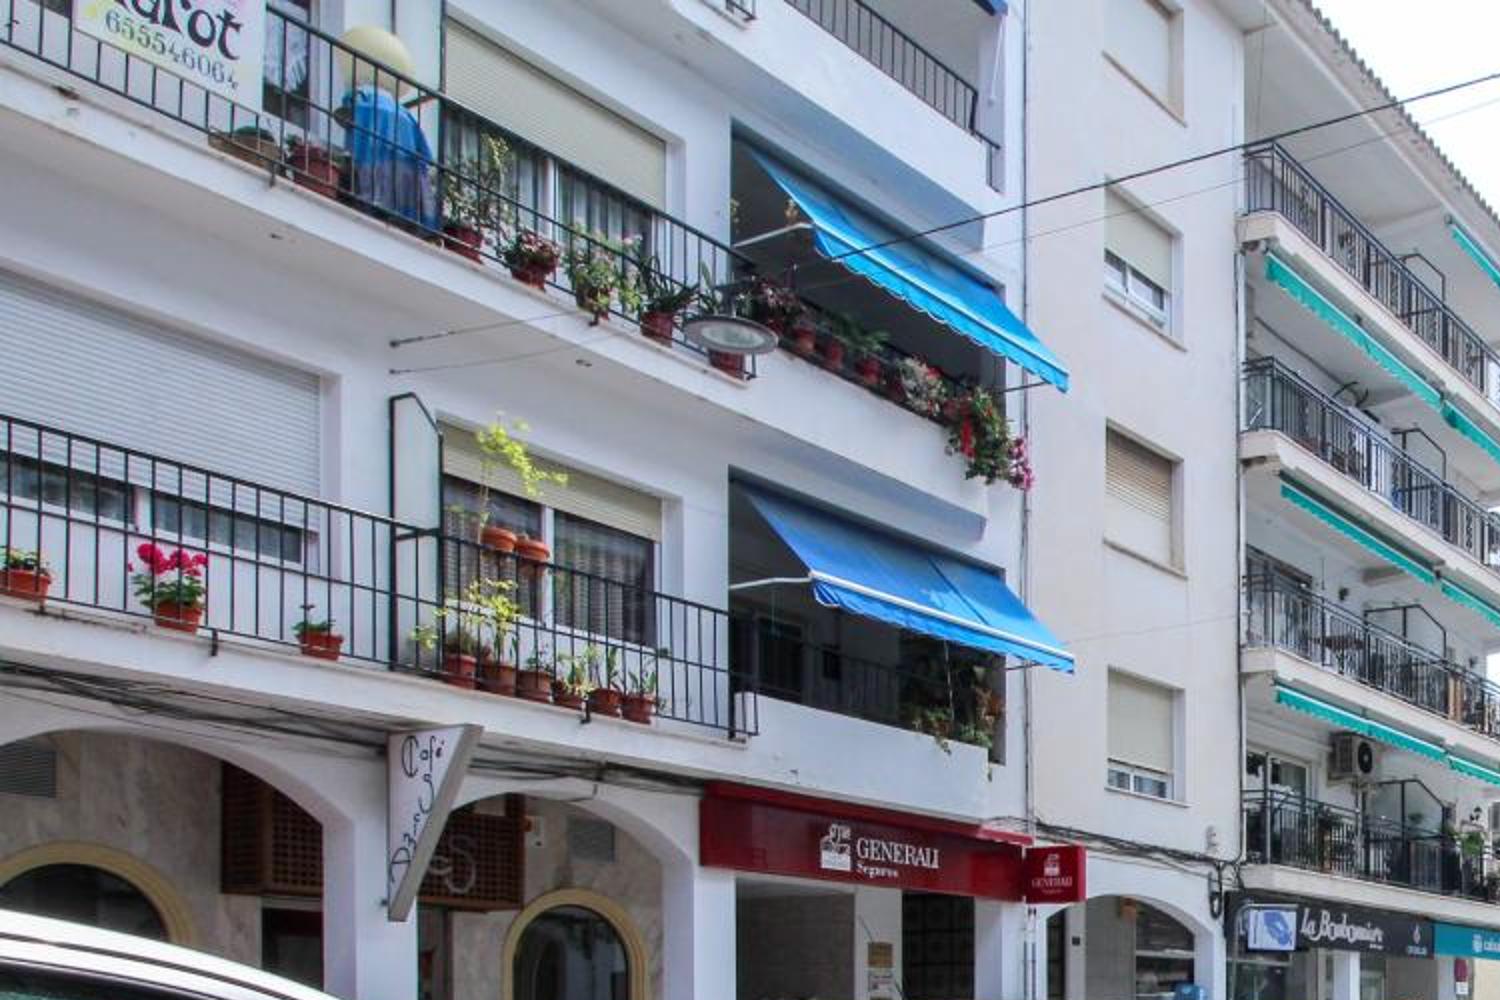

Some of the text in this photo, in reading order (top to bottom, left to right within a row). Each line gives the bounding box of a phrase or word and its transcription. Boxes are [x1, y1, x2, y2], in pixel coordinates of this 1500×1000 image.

[105, 9, 238, 90] 655546064
[114, 0, 242, 60] arot
[401, 735, 446, 778] Café
[856, 837, 940, 869] GENERALI
